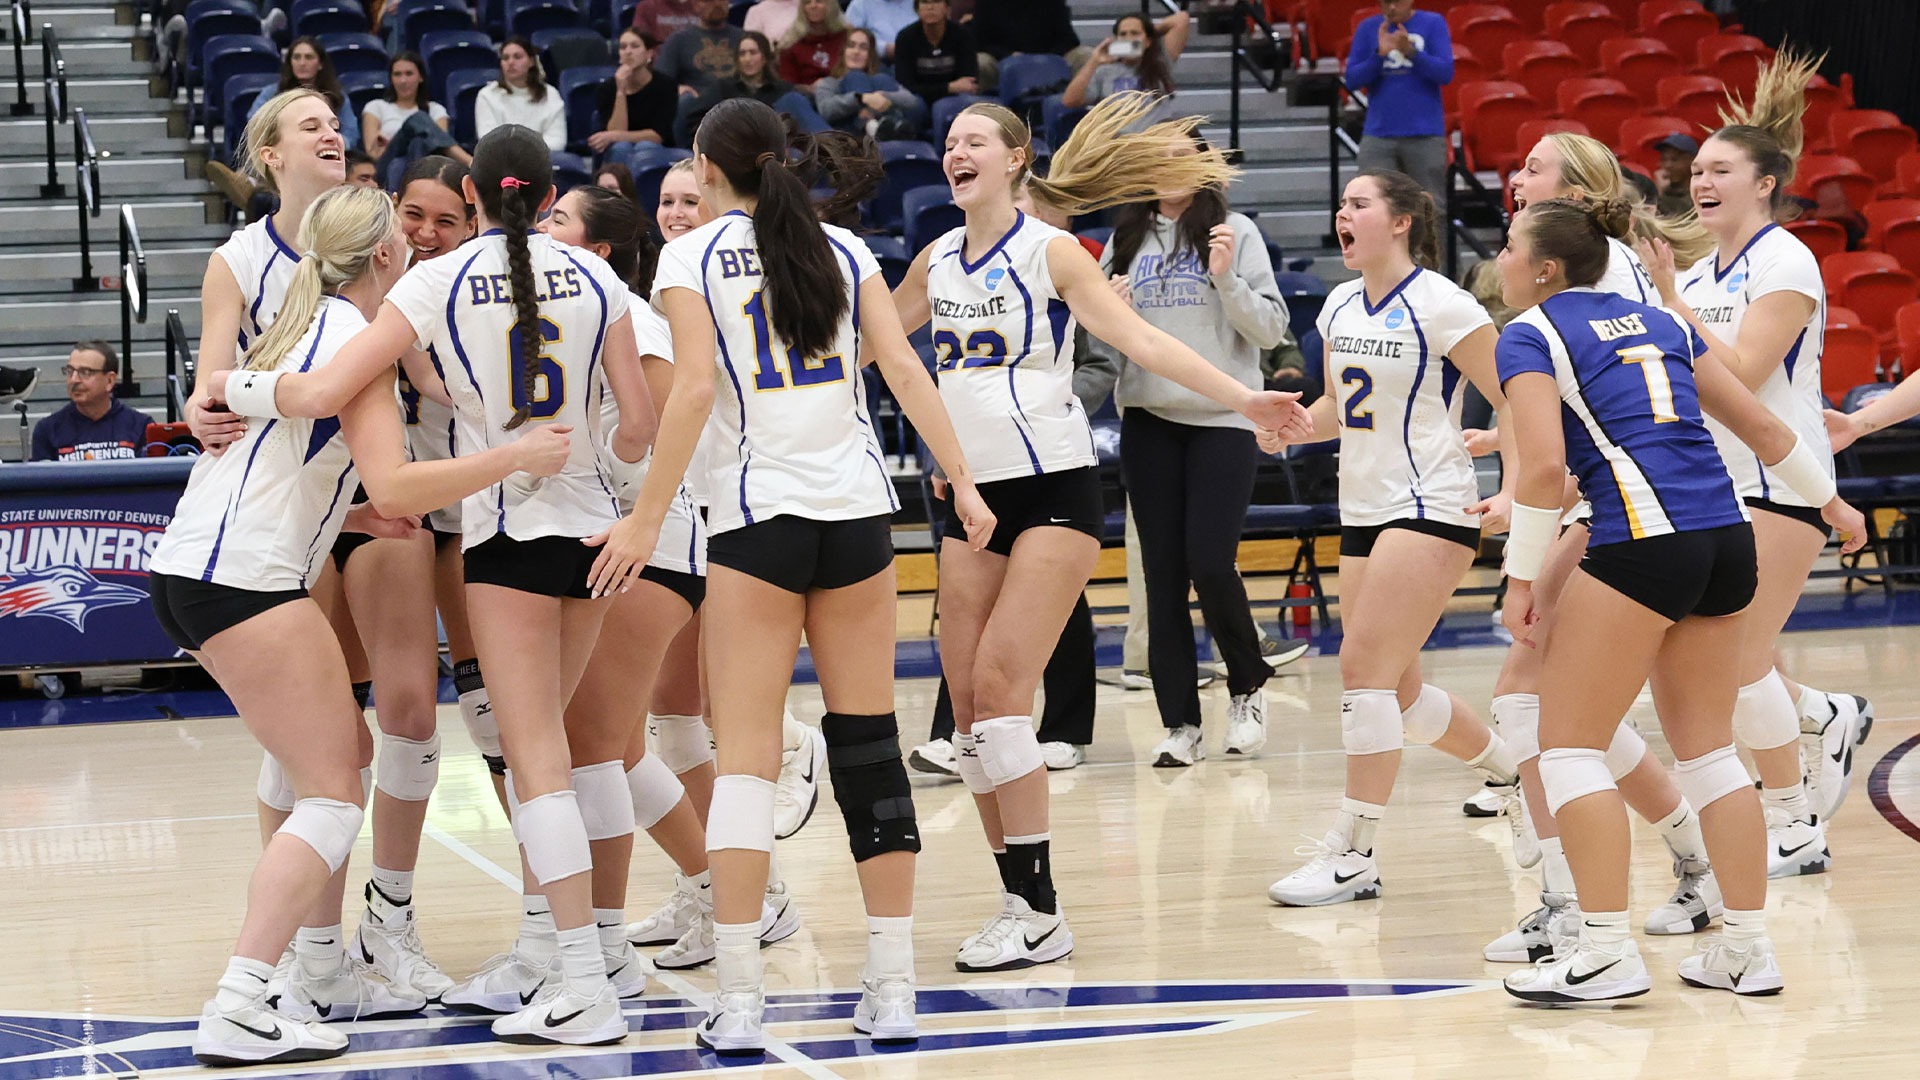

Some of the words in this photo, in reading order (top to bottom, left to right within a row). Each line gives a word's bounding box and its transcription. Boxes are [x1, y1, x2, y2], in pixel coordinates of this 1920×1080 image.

[467, 268, 582, 306] BEES
[967, 296, 1006, 318] STATE
[506, 315, 567, 420] 6
[933, 327, 1010, 374] 22
[1331, 335, 1362, 355] NGELO
[1361, 339, 1403, 359] STATE
[1341, 364, 1375, 432] 2
[1615, 343, 1680, 424] 1
[1, 510, 35, 523] STATE
[38, 509, 106, 521] UNIVERSITY
[108, 510, 122, 522] OF
[124, 511, 171, 526] DENVER
